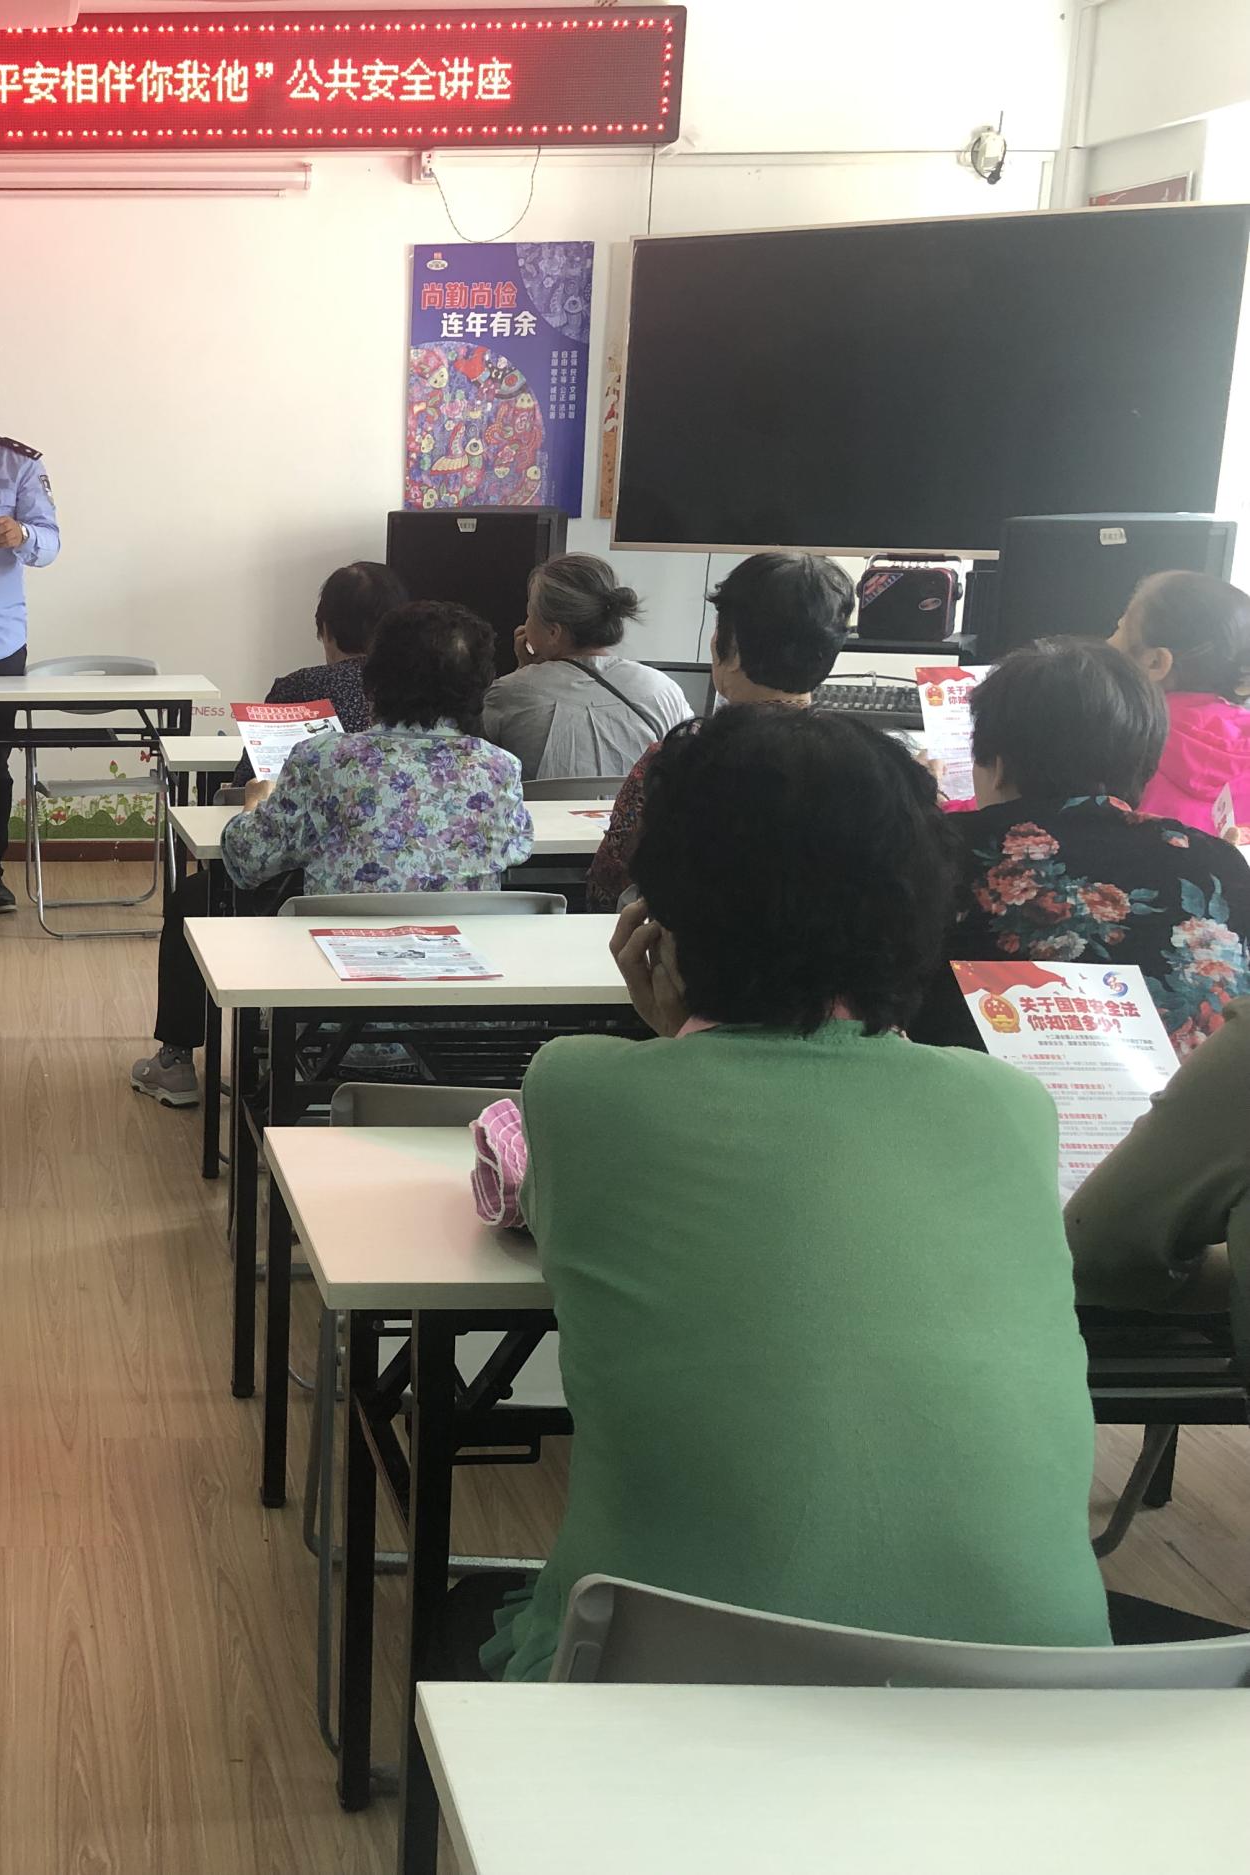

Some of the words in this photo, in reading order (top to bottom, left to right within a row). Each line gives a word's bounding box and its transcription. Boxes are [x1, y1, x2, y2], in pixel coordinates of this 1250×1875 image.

[421, 281, 517, 310] 尚勤尚俭
[440, 311, 537, 338] 连年有余
[1019, 997, 1141, 1018] 关于国家安全法
